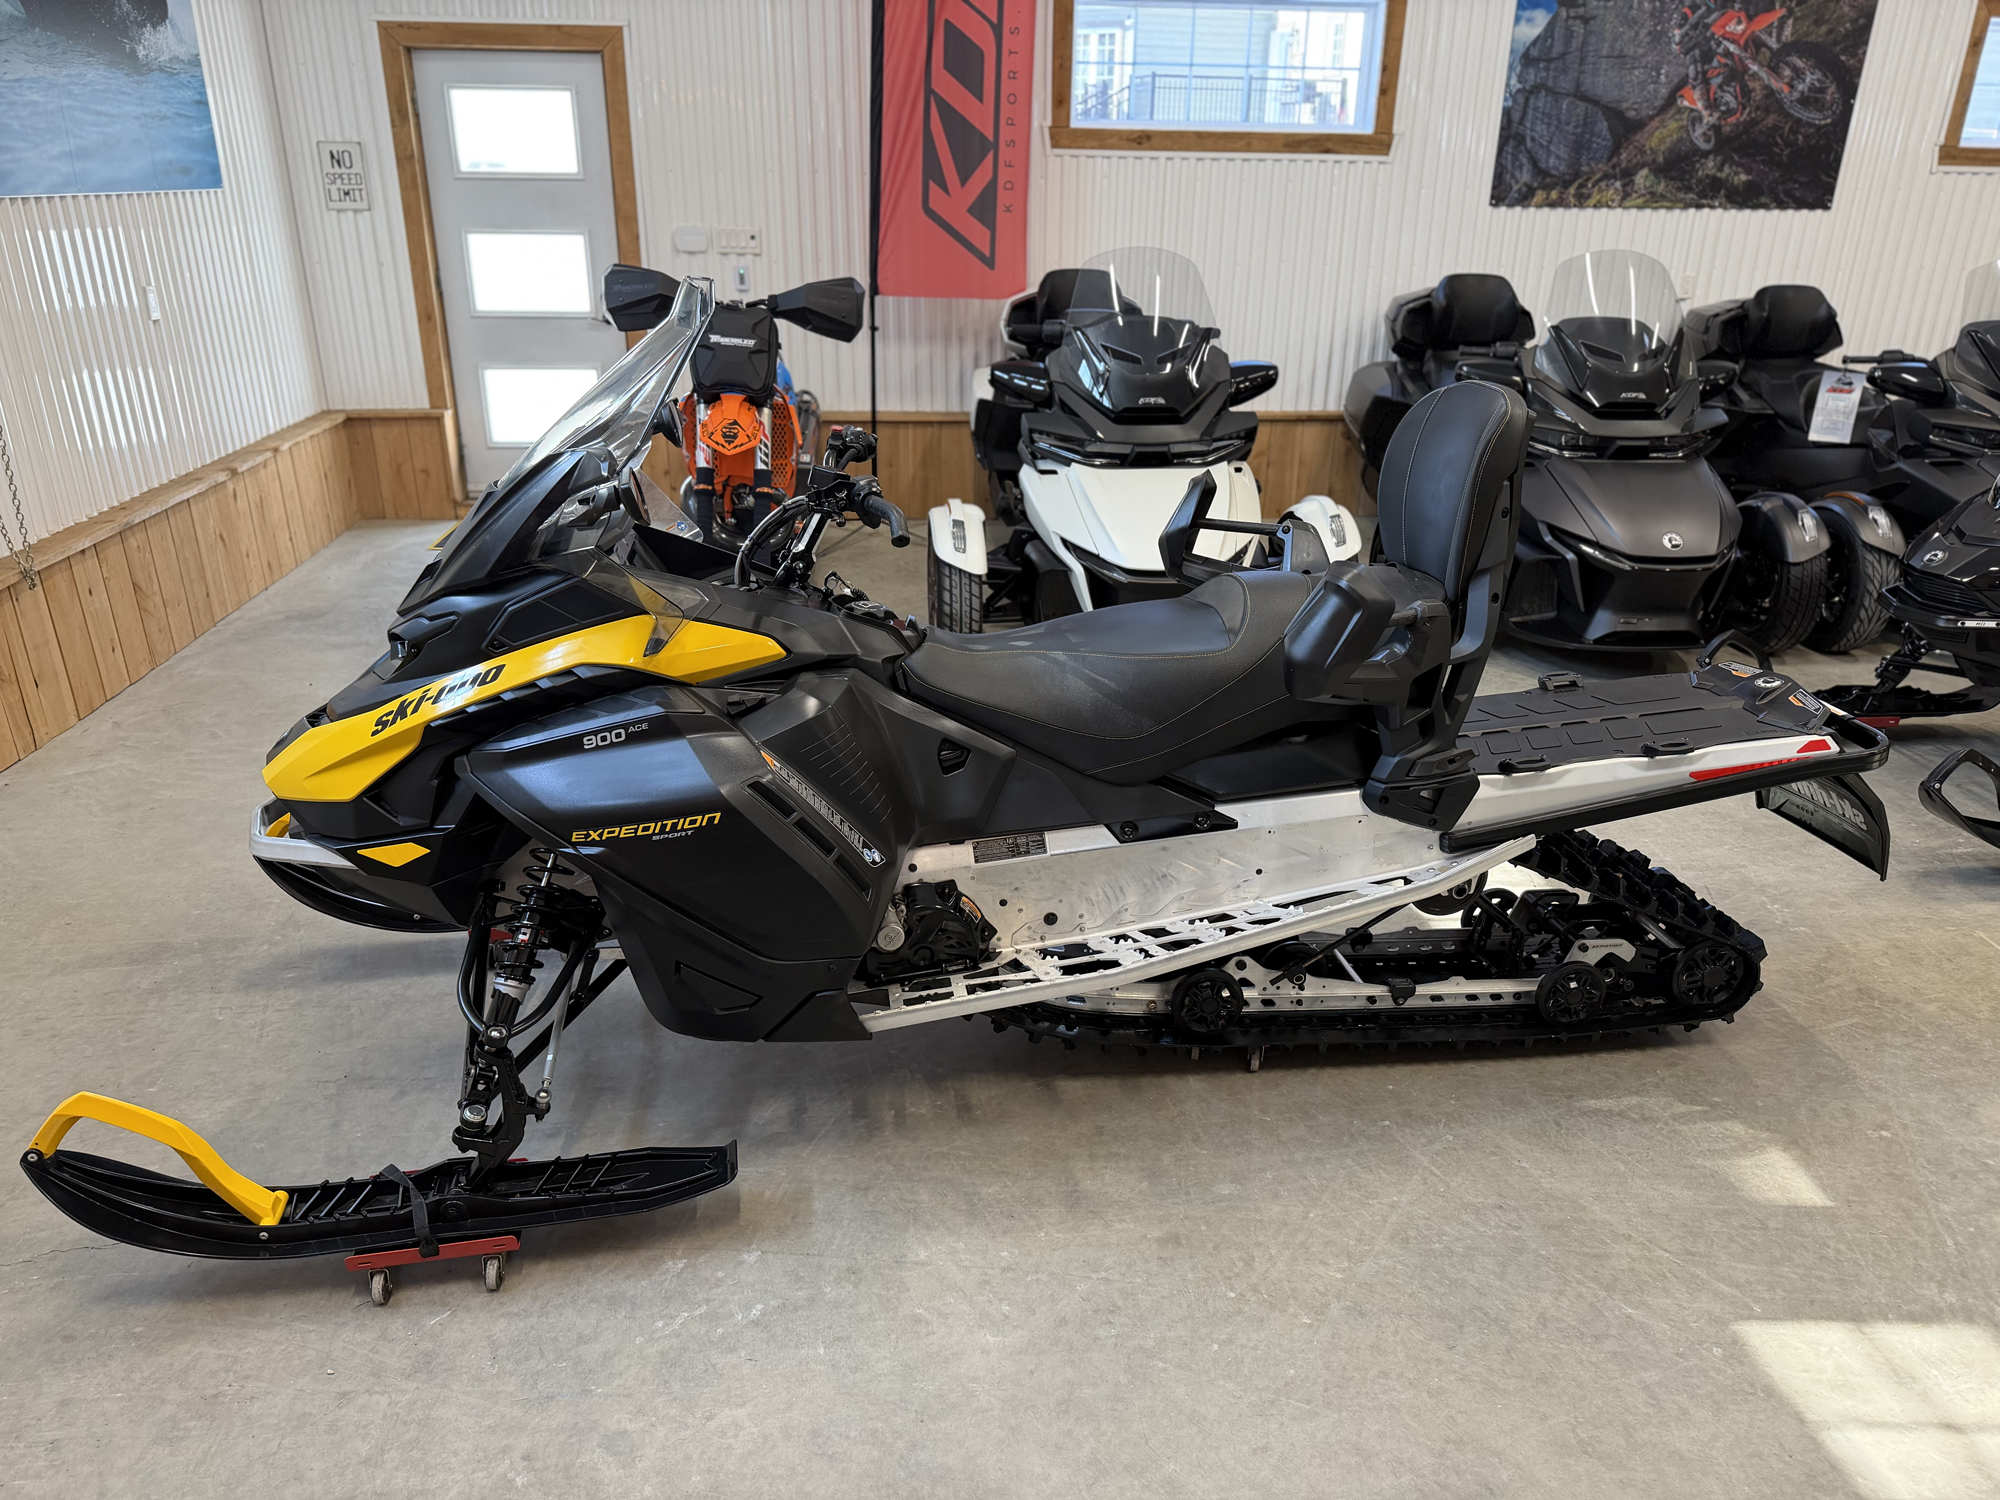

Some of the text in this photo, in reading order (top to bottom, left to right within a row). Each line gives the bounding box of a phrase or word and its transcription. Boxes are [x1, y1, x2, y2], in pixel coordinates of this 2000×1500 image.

[928, 0, 998, 258] KD
[328, 148, 354, 170] NO
[324, 171, 363, 186] SPEED
[327, 187, 364, 202] LIMIT
[582, 722, 649, 749] 900 ACE
[571, 812, 722, 842] EXPEDITION
[651, 829, 695, 841] SPORT
